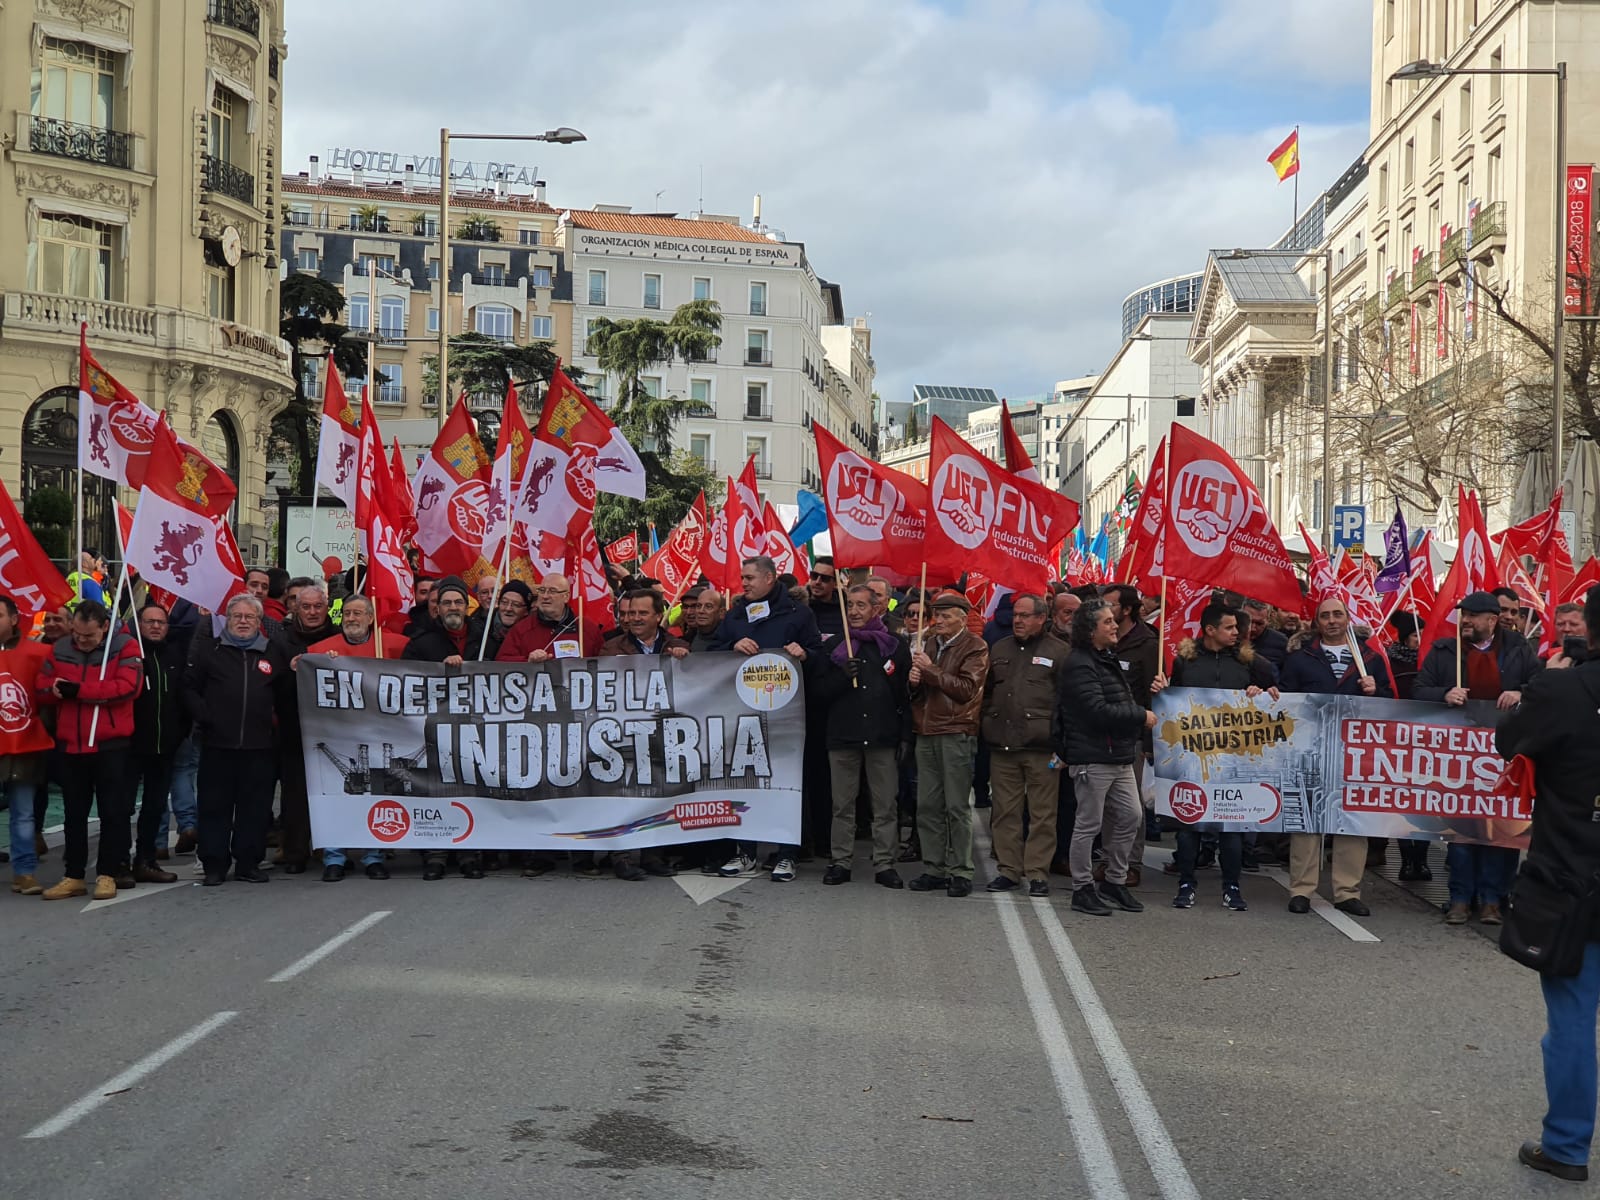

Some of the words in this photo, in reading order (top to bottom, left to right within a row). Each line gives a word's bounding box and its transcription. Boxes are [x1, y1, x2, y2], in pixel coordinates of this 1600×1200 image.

[332, 148, 403, 174] HOTEL
[581, 234, 650, 249] ORGANIZACIÓN
[654, 239, 690, 252] MÉDICA
[691, 244, 737, 256] COLEGIAL
[739, 247, 752, 257] DE
[755, 248, 789, 260] ESPAÑA
[1179, 471, 1239, 522] UGT
[1342, 511, 1363, 539] P
[991, 527, 1037, 552] Industria,
[1233, 529, 1278, 554] Industria,
[315, 669, 365, 709] EN
[378, 672, 557, 715] DEFENSA
[1180, 710, 1263, 731] SALVEMOS
[1268, 710, 1286, 723] LA
[1347, 721, 1387, 744] EN
[1181, 724, 1288, 753] INDUSTRIA
[437, 715, 772, 790] INDUSTRIA
[1346, 747, 1506, 793] INDUS
[1173, 786, 1202, 806] UGT
[1213, 789, 1243, 801] FICA
[372, 807, 403, 824] UGT
[413, 808, 442, 820] FICA
[676, 802, 730, 818] UNIDOS:
[682, 818, 712, 827] HACIENDO
[713, 816, 737, 824] FUTURO
